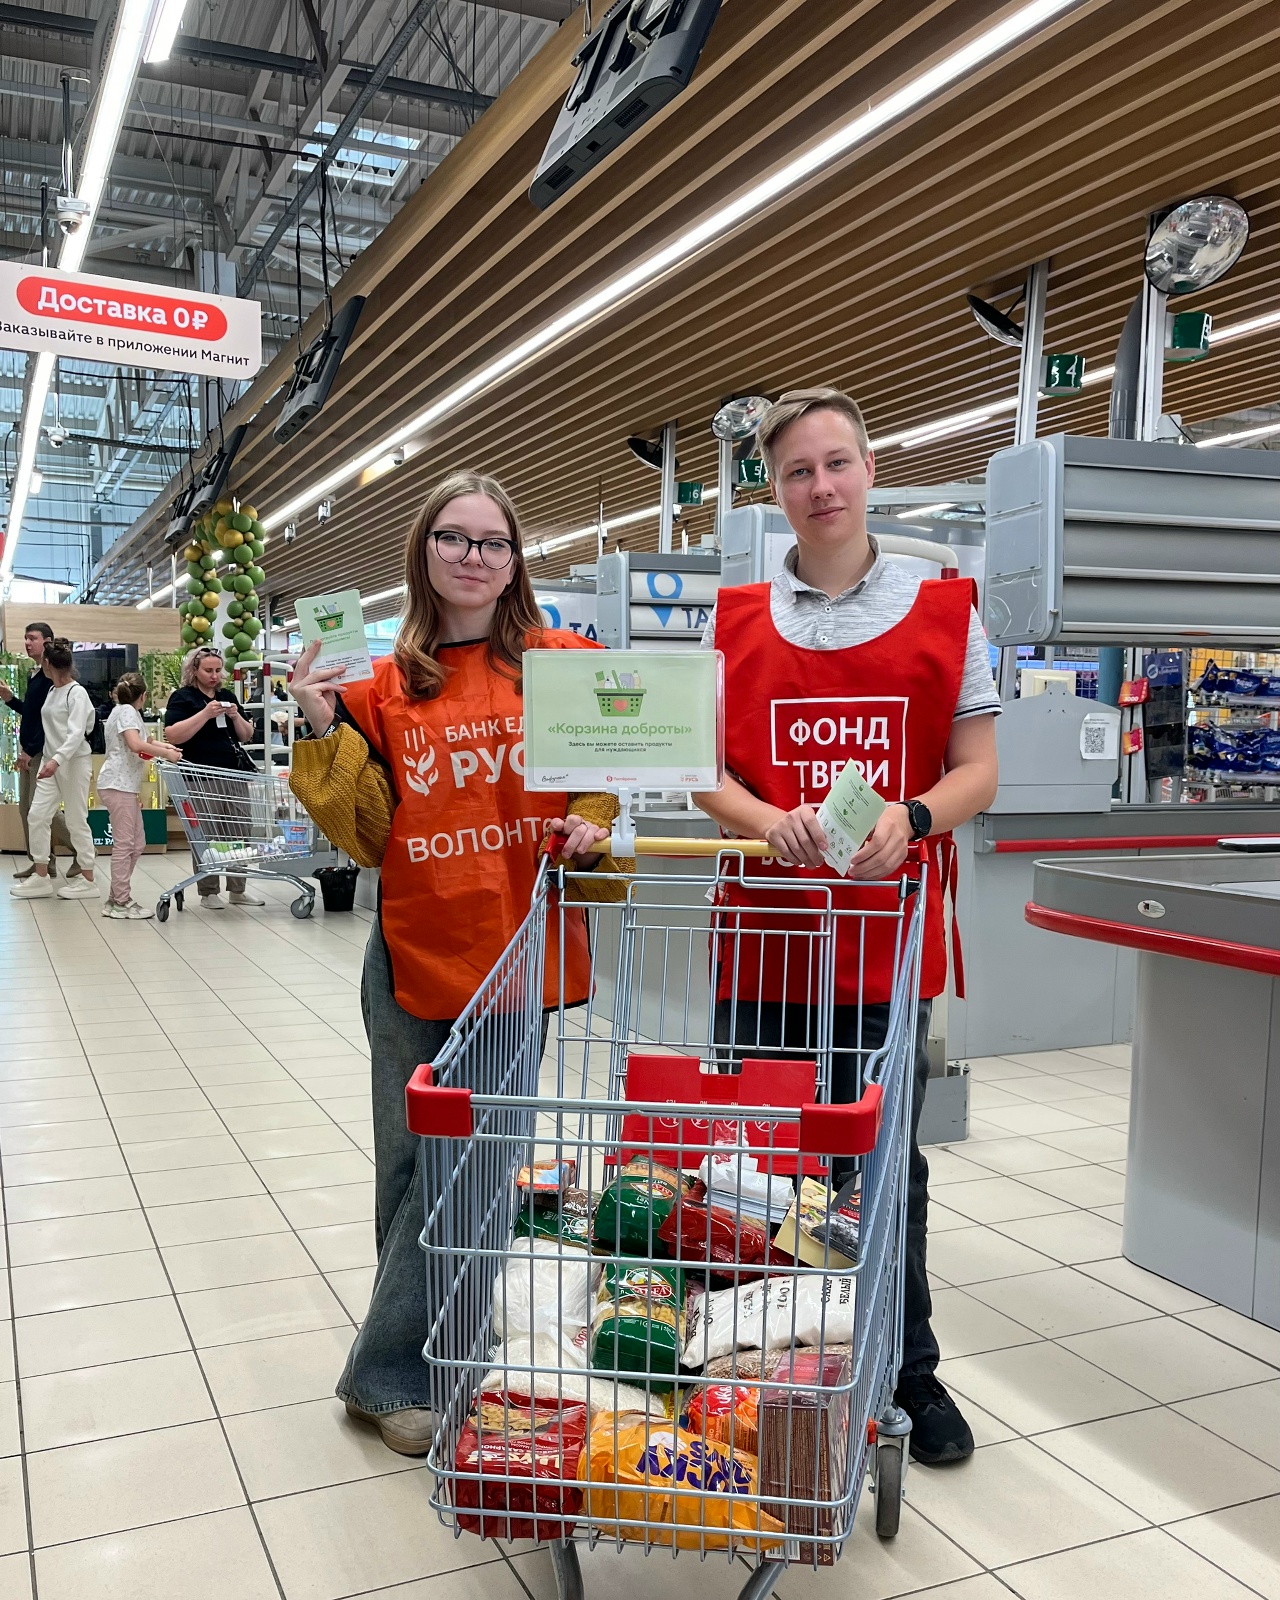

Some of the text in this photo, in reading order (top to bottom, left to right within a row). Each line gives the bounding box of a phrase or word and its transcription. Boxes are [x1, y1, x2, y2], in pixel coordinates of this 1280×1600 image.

[38, 286, 167, 326] Доставка
[96, 336, 104, 345] в
[108, 336, 197, 359] приложении
[201, 349, 250, 366] Магнит
[754, 465, 761, 476] 5
[692, 488, 699, 499] 6
[681, 607, 708, 629] ТА
[569, 622, 598, 642] ТА
[445, 716, 524, 743] БАНК ЕД
[548, 722, 693, 737] «Корзина доброты»
[789, 716, 890, 750] ФОНД
[450, 740, 525, 789] РУС
[406, 816, 552, 863] ВОЛОНТ
[839, 1277, 852, 1305] БЕЛЫЙ
